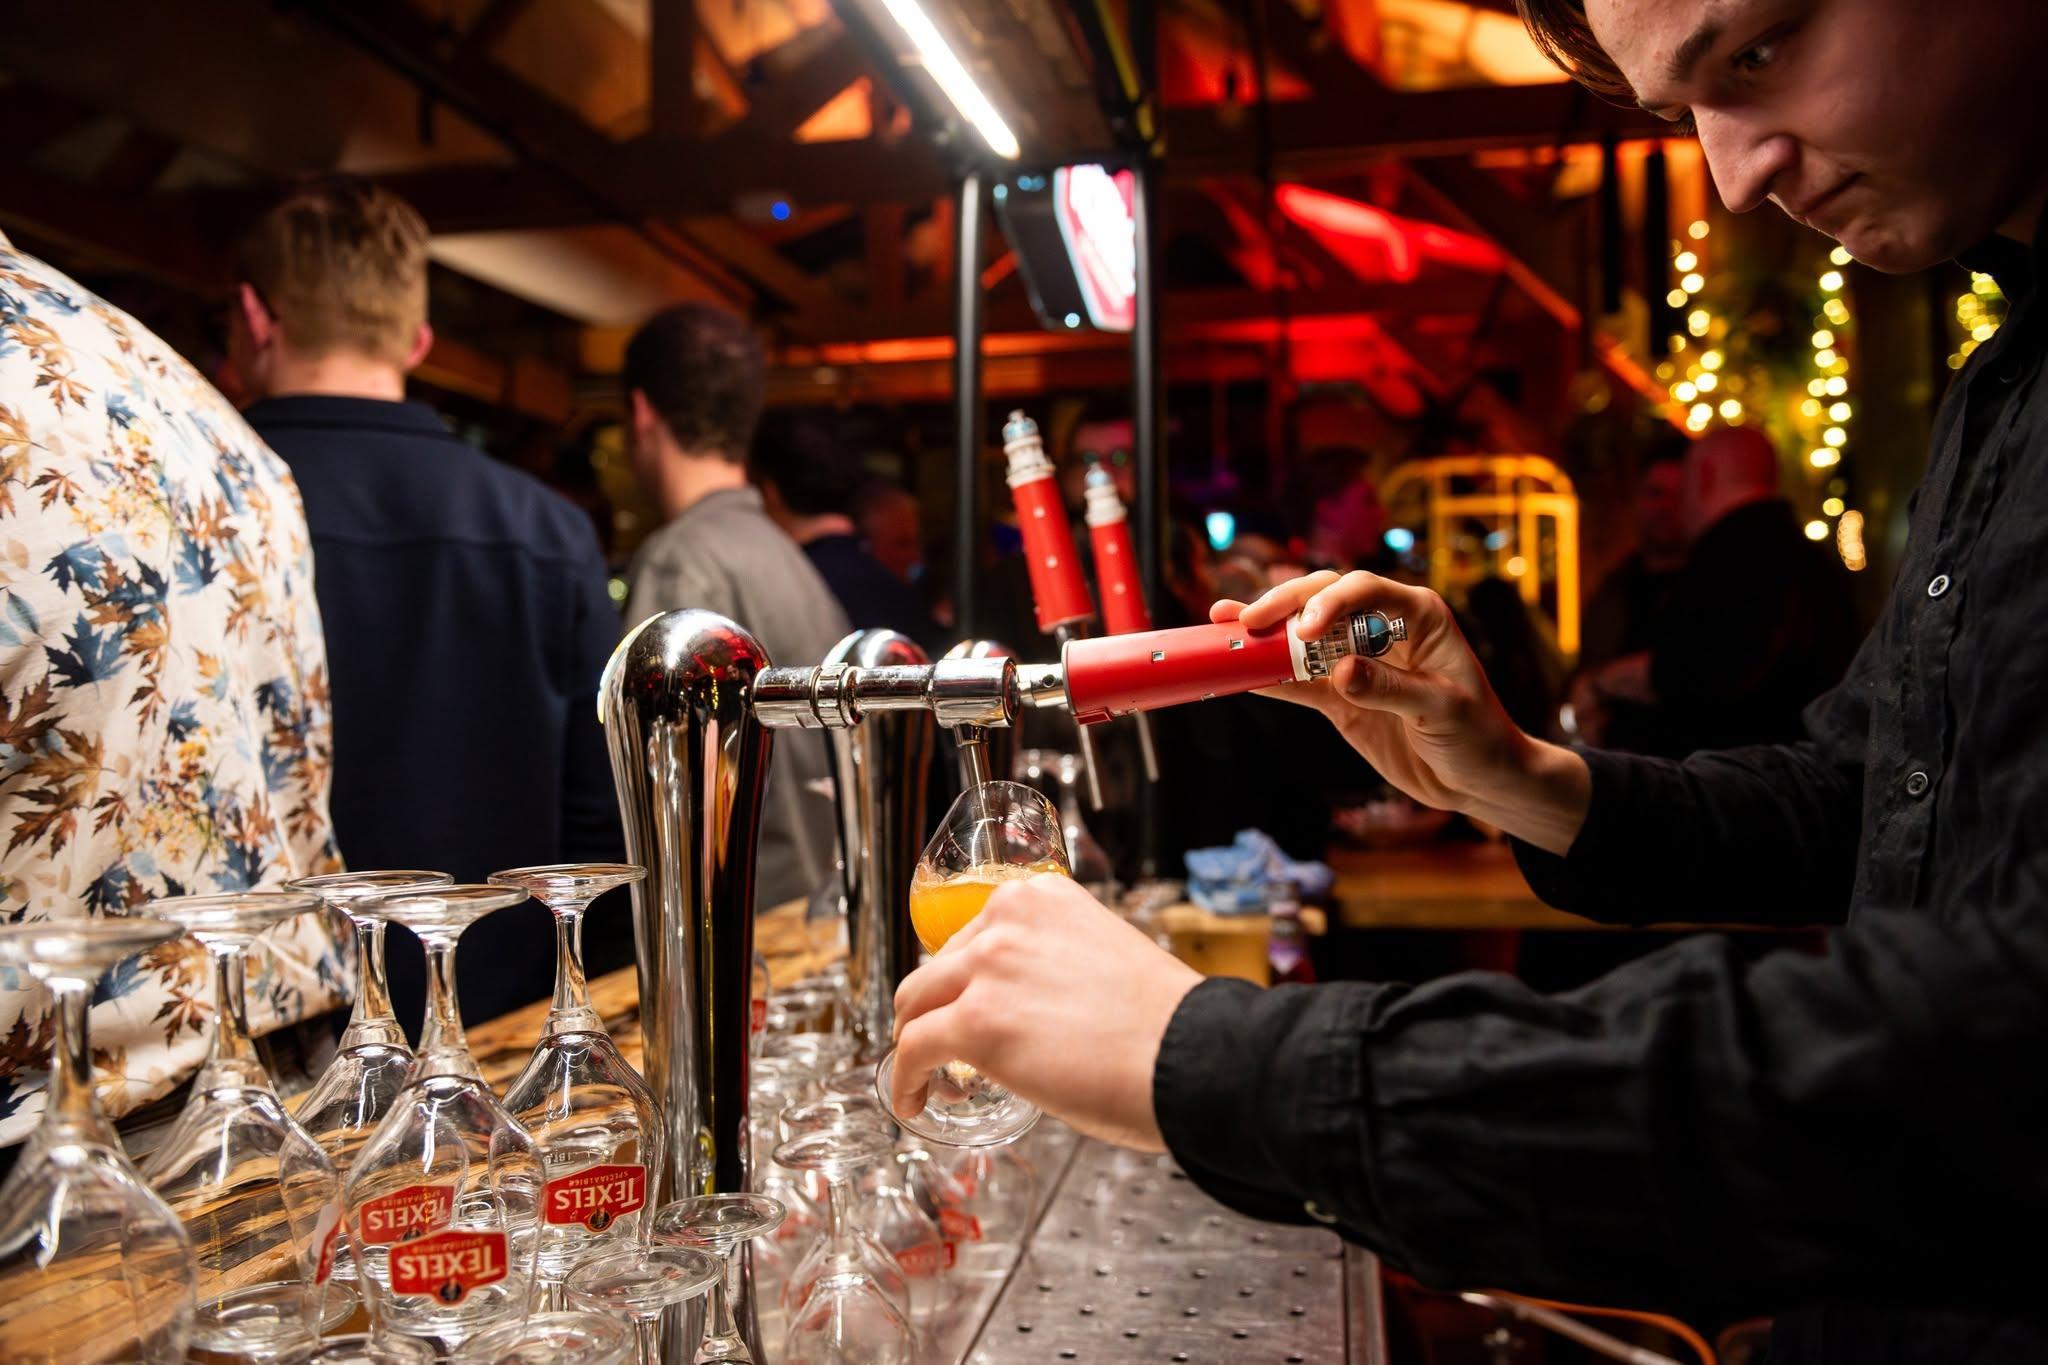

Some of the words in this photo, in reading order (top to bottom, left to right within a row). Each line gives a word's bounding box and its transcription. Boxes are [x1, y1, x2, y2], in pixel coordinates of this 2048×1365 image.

[554, 1178, 640, 1210] TEXELS
[367, 1196, 451, 1229] TEXELS
[397, 1245, 501, 1280] TEXELS
